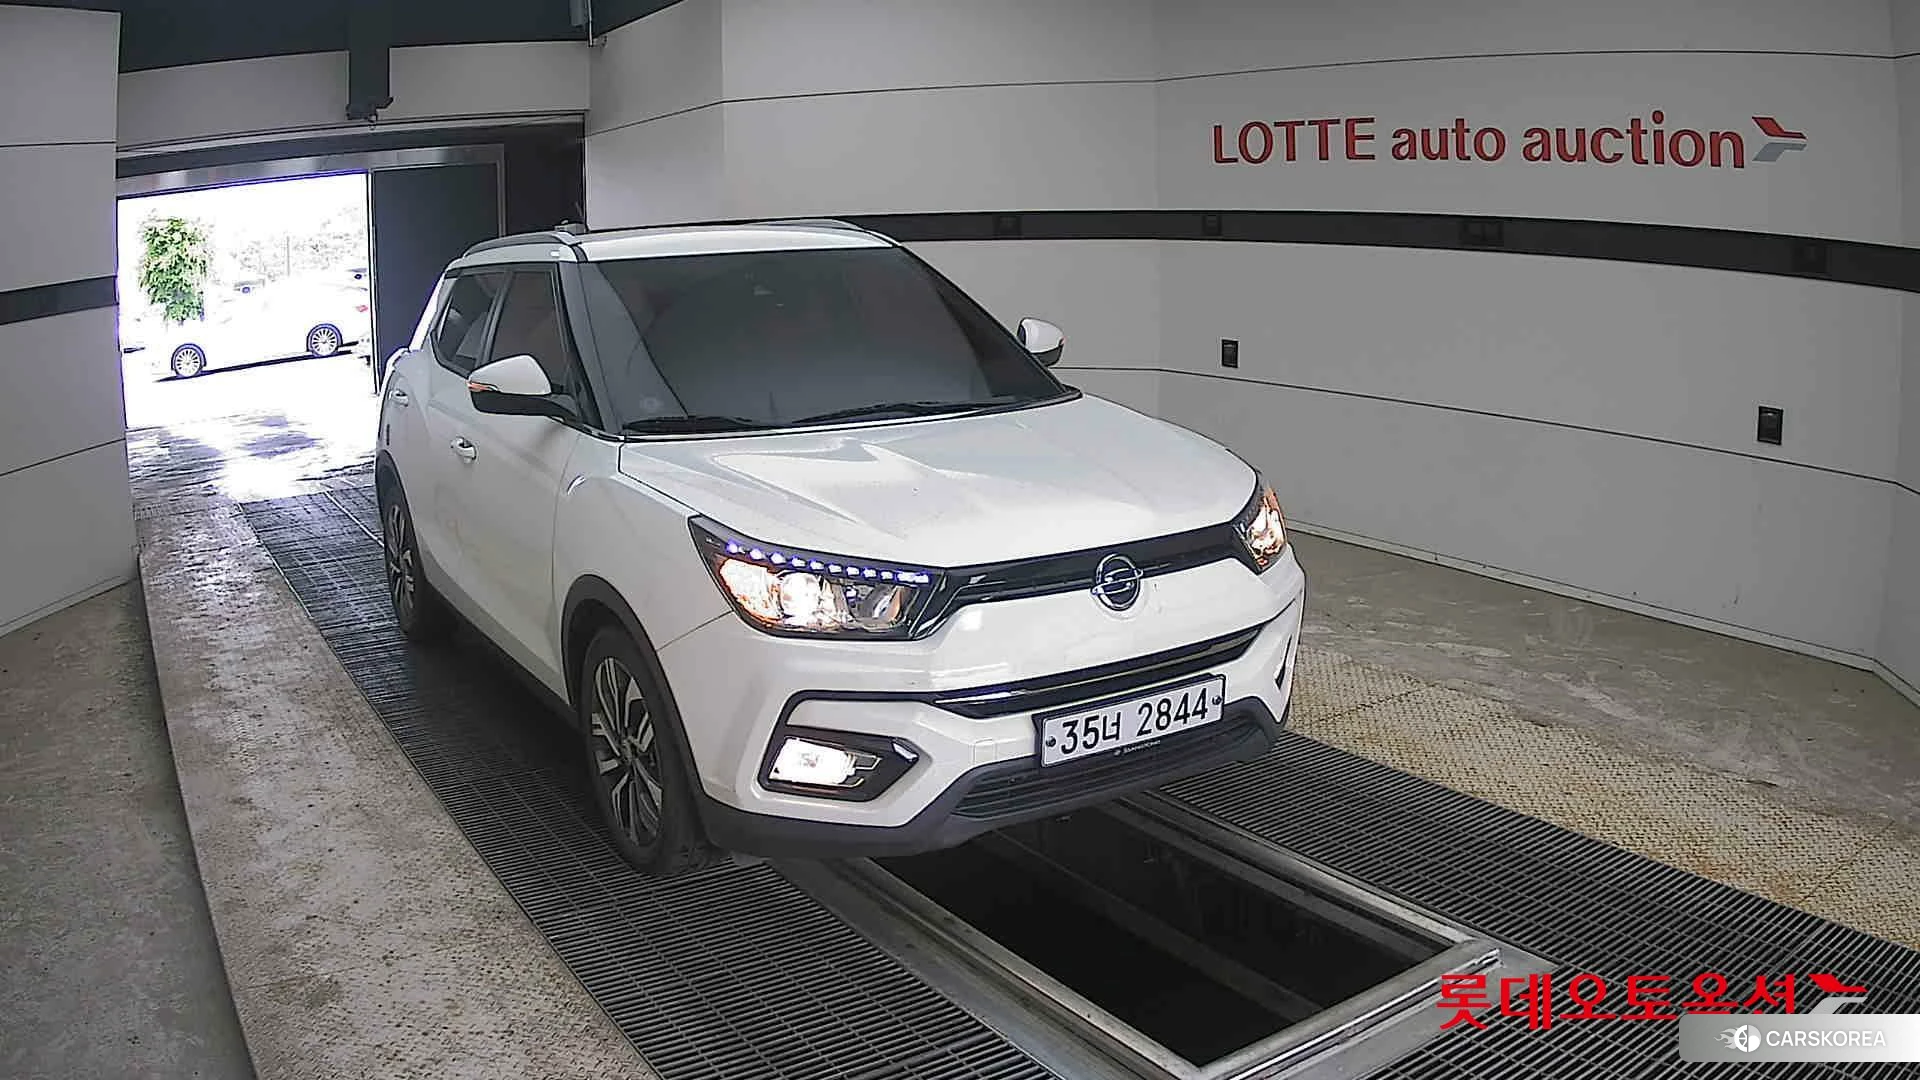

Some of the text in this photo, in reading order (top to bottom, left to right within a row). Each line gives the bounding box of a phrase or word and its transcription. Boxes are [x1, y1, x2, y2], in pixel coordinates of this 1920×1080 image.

[1213, 110, 1745, 169] LOTTE auto auction
[1061, 688, 1208, 754] 35너 2844
